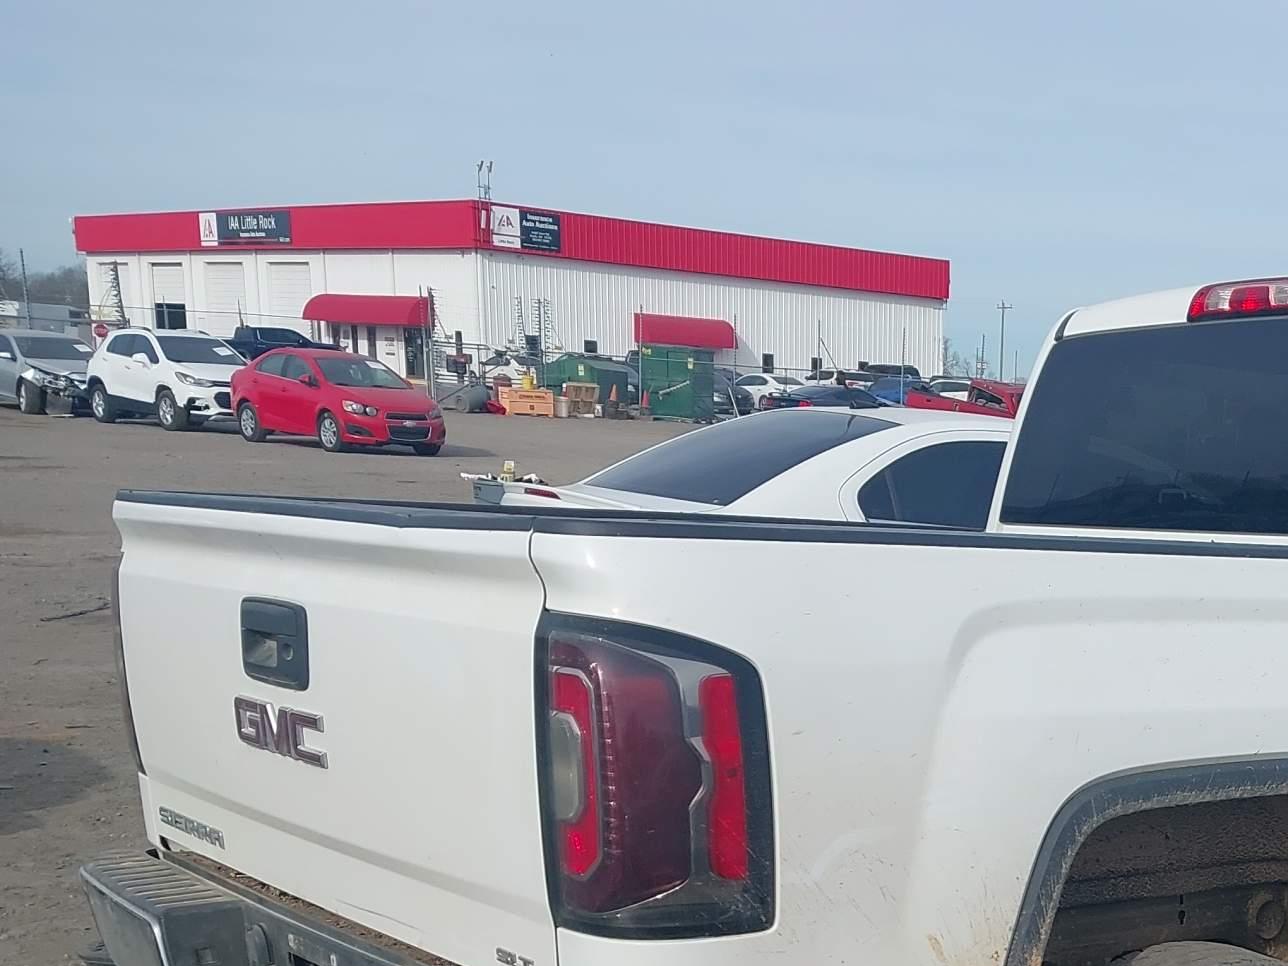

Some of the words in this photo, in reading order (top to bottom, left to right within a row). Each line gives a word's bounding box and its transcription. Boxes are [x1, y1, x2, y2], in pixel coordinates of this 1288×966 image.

[228, 215, 240, 230] IAA
[240, 214, 257, 230] Little
[258, 214, 277, 230] Rock
[234, 694, 329, 770] GMC
[158, 806, 226, 850] SIERRA
